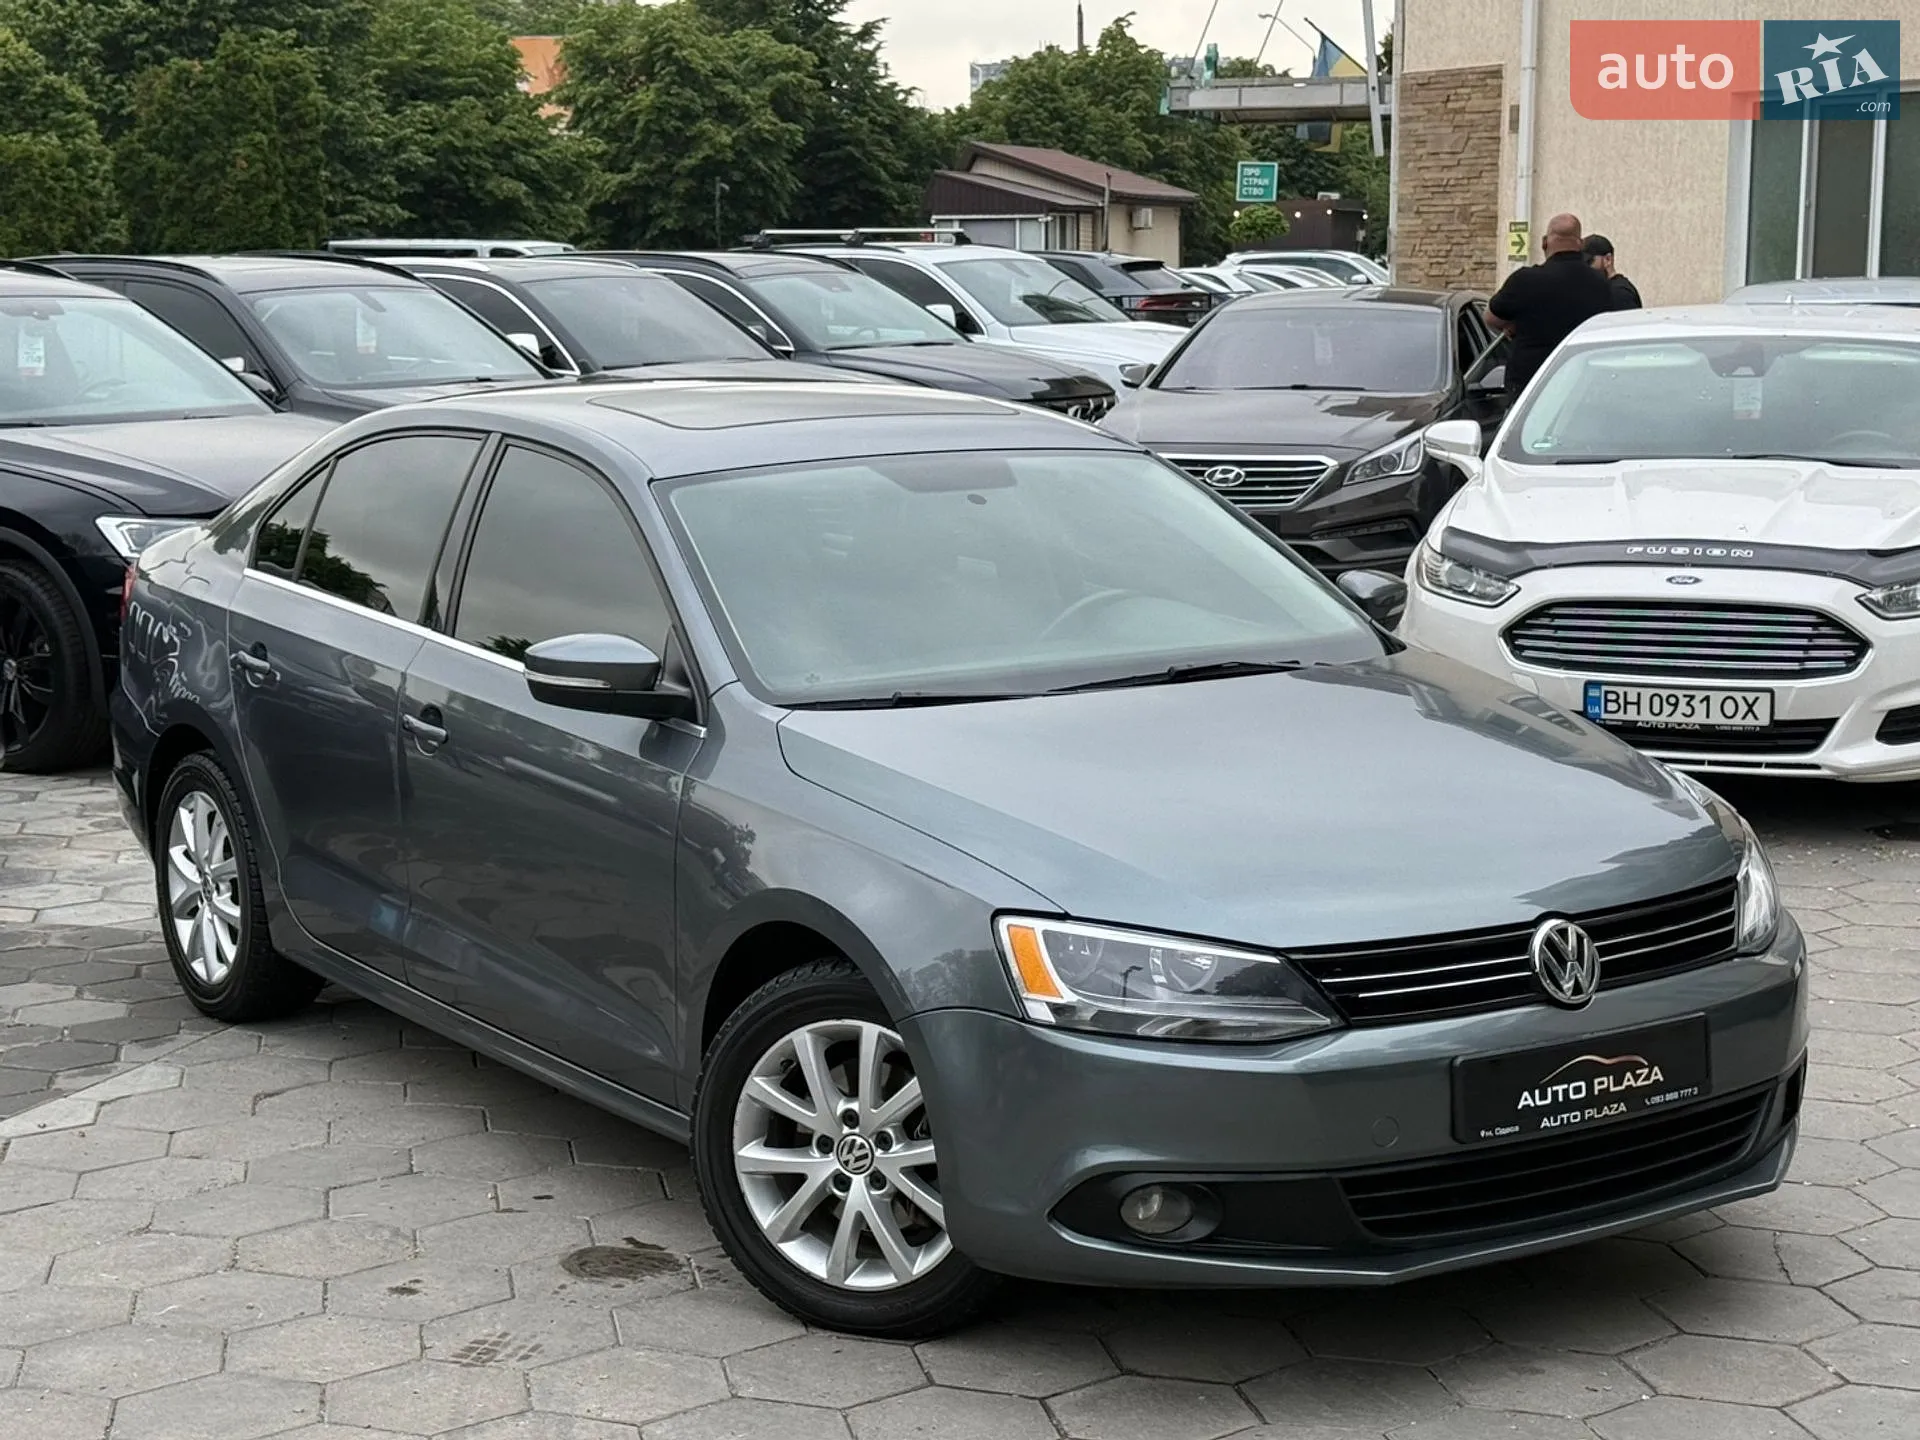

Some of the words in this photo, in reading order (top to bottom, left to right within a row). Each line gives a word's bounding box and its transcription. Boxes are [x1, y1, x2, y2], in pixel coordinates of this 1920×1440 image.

[1626, 546, 1754, 558] FUSION
[1603, 690, 1641, 716] BH
[1649, 693, 1711, 720] 0931
[1719, 695, 1760, 721] OX
[1636, 720, 1667, 730] AUTO
[1667, 722, 1701, 730] PLAZA
[1517, 1081, 1587, 1109] AUTO
[1593, 1065, 1664, 1096] PLAZA
[1540, 1110, 1581, 1129] AUTO
[1585, 1102, 1627, 1121] PLAZA
